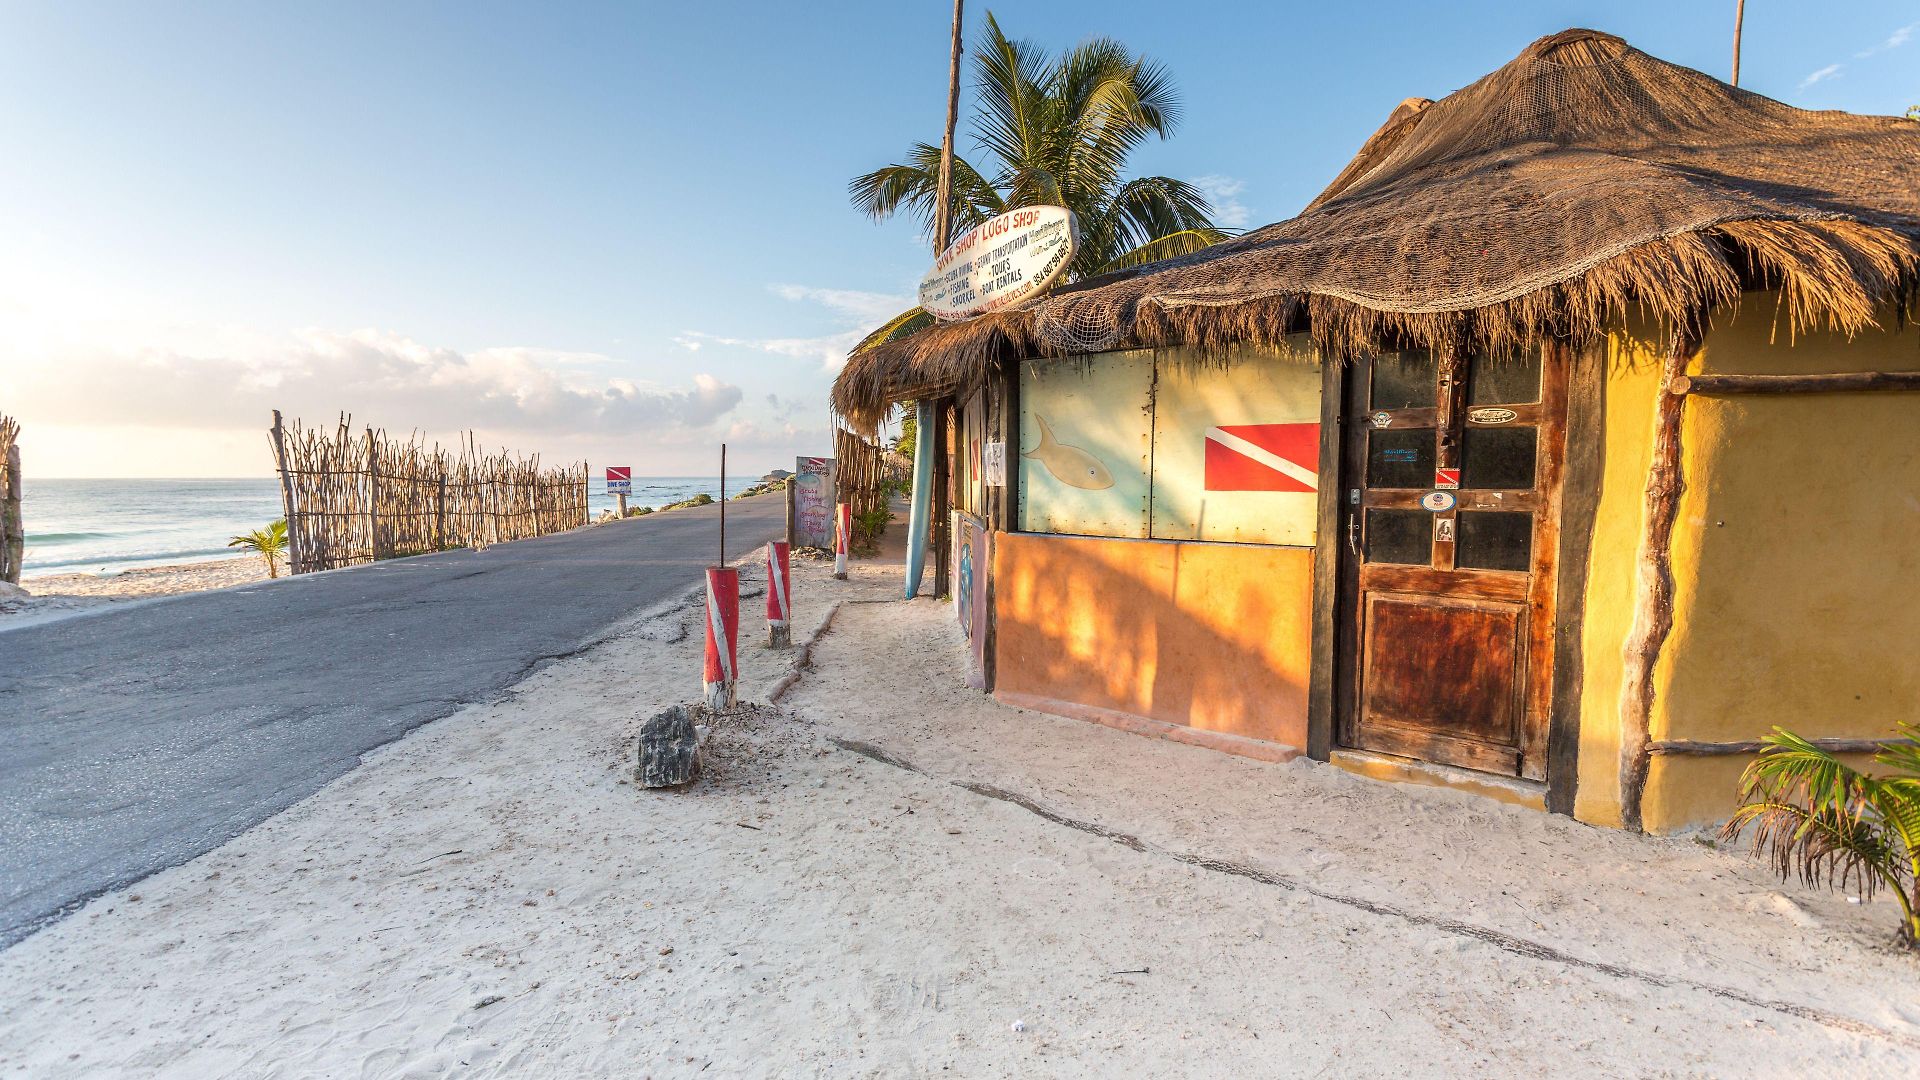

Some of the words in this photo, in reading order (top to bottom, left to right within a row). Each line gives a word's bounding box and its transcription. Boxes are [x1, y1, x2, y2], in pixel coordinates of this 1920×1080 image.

[937, 247, 954, 271] DIVE
[956, 229, 978, 256] SHOP
[982, 215, 1009, 241] LOGO
[1013, 210, 1040, 229] SHOP
[991, 257, 1011, 278] TOURS
[951, 277, 970, 296] FISHING
[996, 268, 1022, 291] RENTALS
[952, 288, 976, 308] SNORKEL
